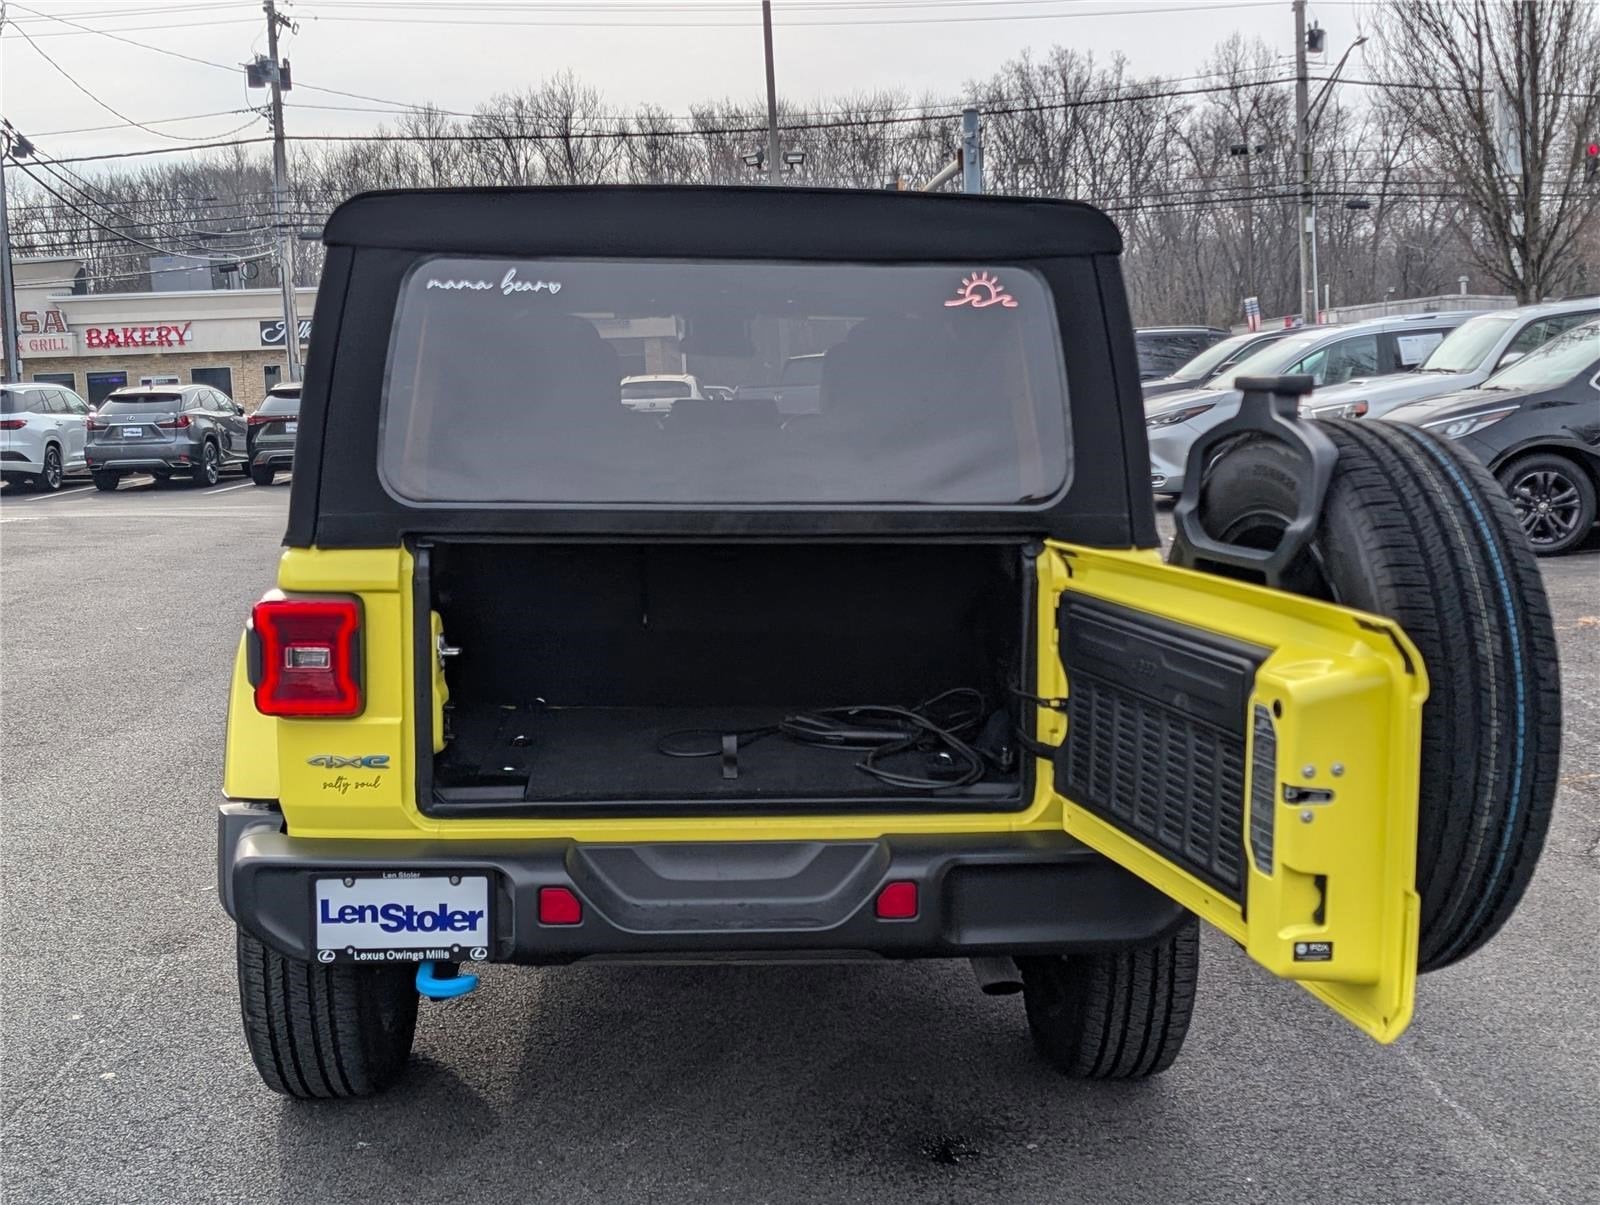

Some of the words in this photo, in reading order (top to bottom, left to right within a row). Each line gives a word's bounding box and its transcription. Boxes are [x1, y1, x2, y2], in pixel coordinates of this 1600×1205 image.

[426, 278, 494, 290] mama
[500, 267, 549, 295] bear
[86, 321, 192, 348] BAKERY
[29, 338, 68, 351] GRILL
[323, 775, 351, 795] salty
[354, 775, 382, 789] soul
[398, 871, 421, 879] Stoler
[353, 950, 385, 961] Lexus
[386, 949, 424, 962] Owings
[425, 948, 450, 960] Mills
